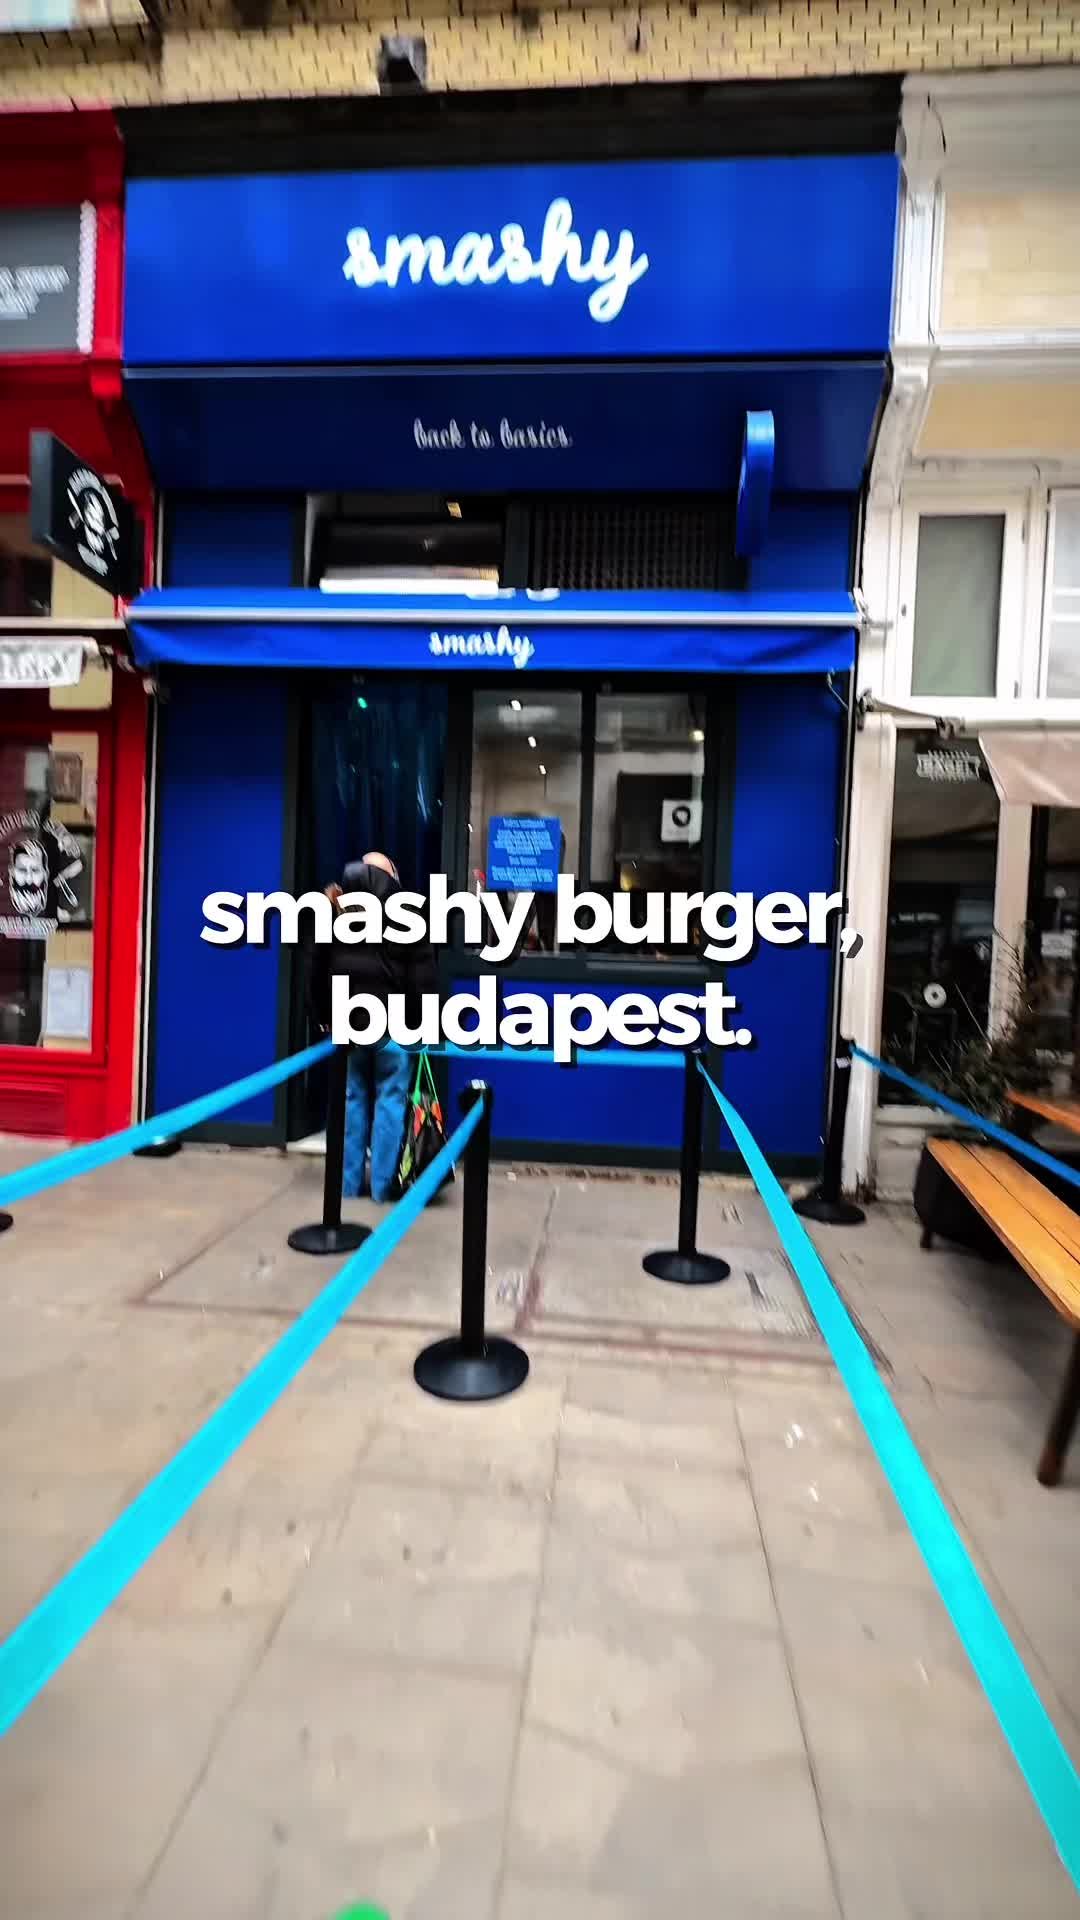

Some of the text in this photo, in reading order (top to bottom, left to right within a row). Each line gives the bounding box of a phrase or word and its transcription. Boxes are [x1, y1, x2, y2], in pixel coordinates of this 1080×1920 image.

[343, 199, 648, 322] smashy
[413, 417, 573, 450] back to basics
[429, 625, 535, 669] smashy
